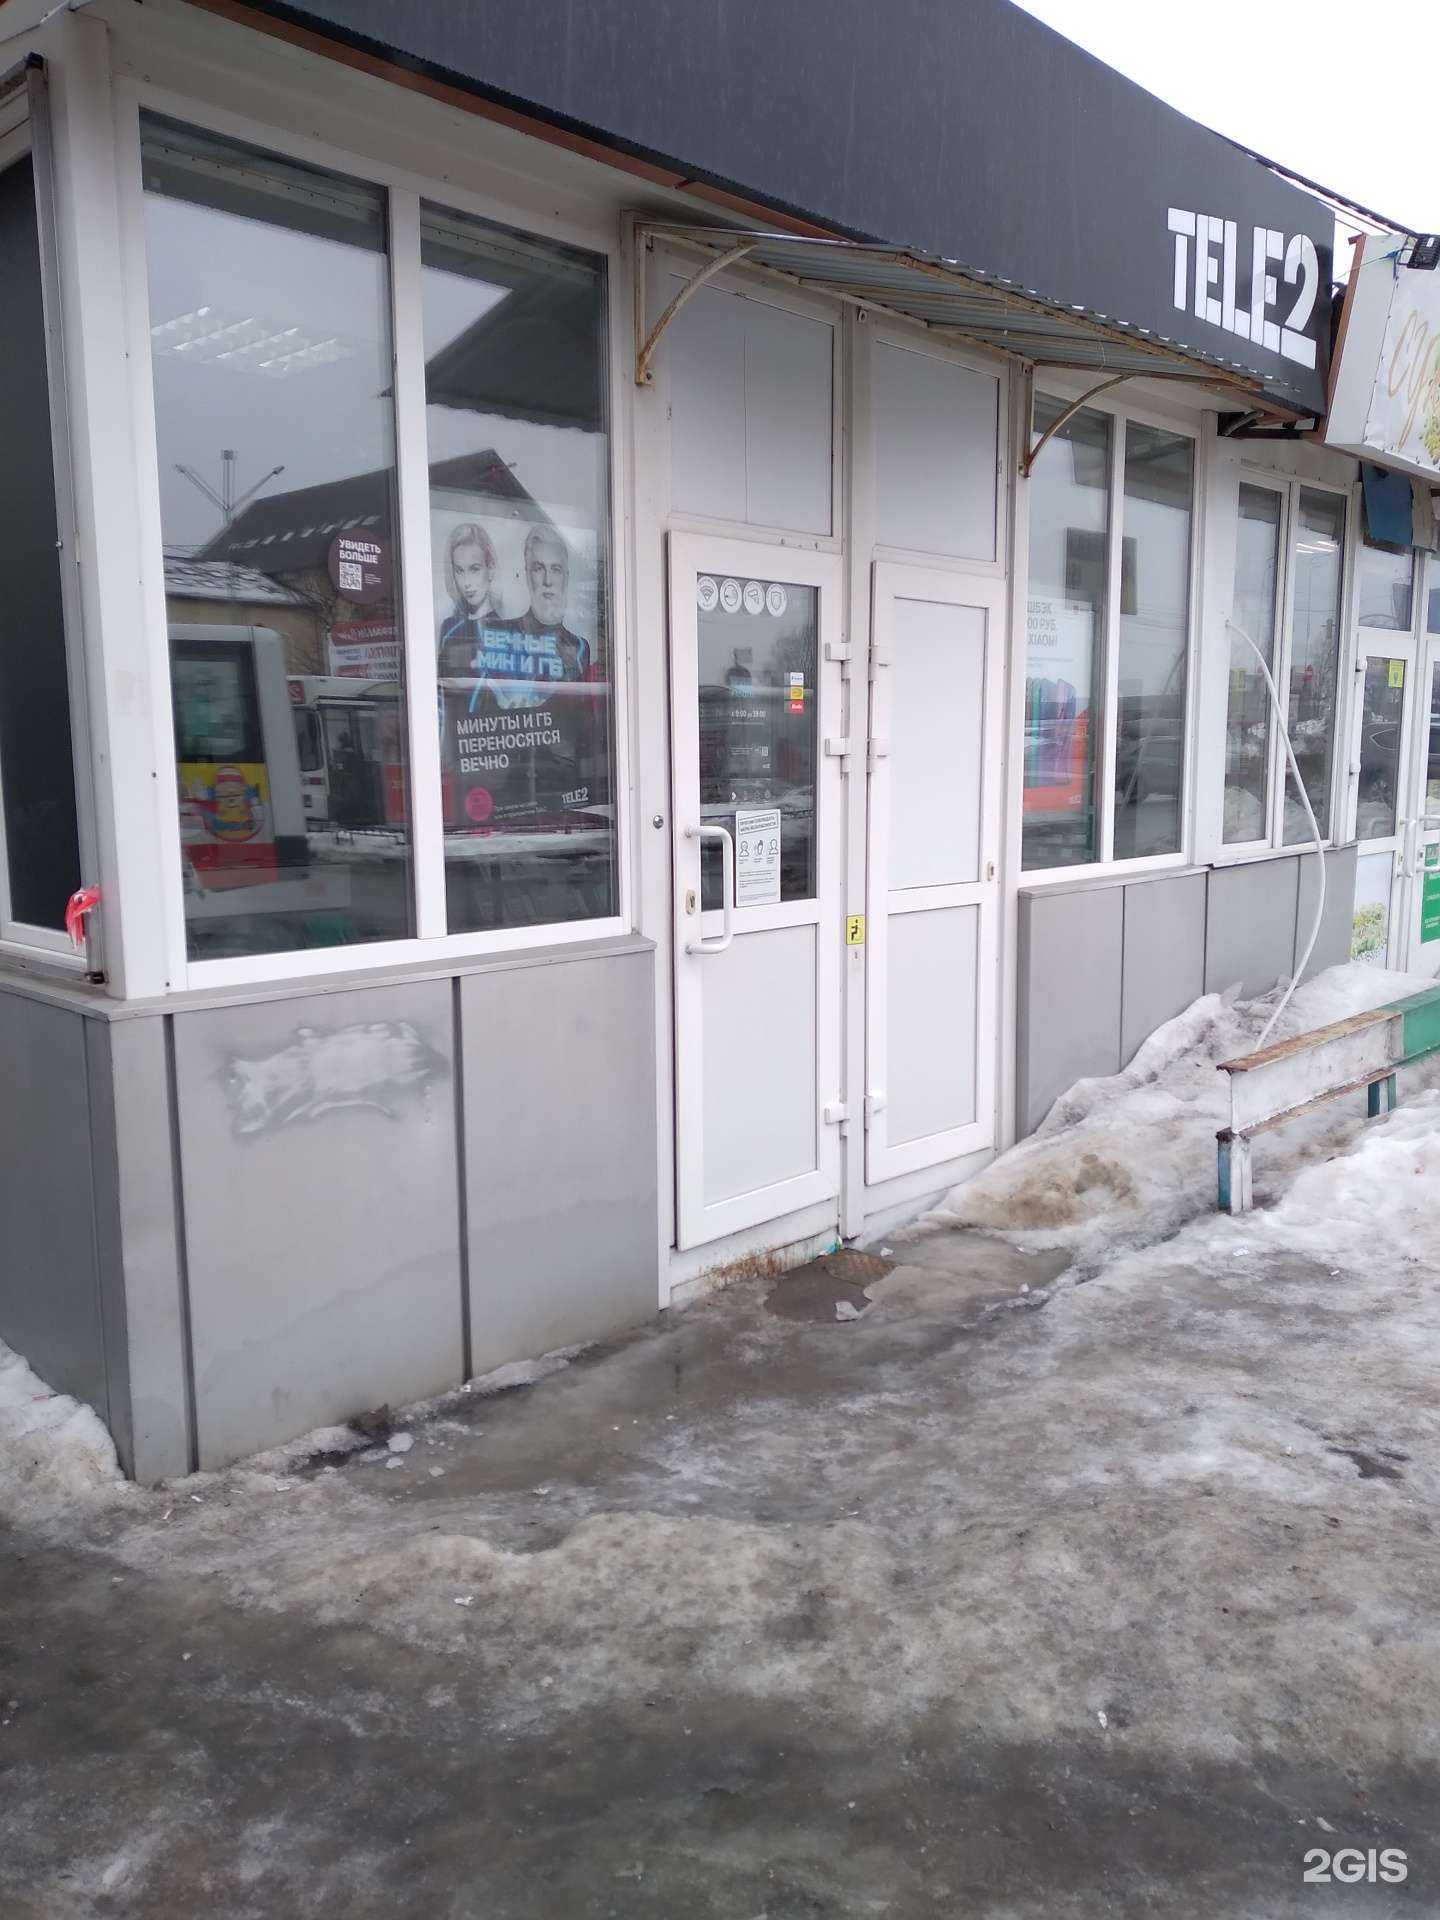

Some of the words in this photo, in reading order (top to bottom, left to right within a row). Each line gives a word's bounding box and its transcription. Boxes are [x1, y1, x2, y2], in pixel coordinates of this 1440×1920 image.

[1167, 207, 1319, 370] TELE2
[338, 538, 382, 554] УВИДЕТЬ
[339, 549, 378, 564] БОЛЬШЕ
[483, 629, 557, 655] ВЕЧНЫЕ
[475, 650, 516, 672] МИН
[520, 654, 534, 673] И
[539, 656, 563, 679] ГБ
[457, 715, 520, 735] МИНУТЫ
[523, 713, 534, 728] И
[536, 711, 552, 728] ГБ
[458, 729, 560, 754] ПЕРЕНОСЯТСЯ
[460, 754, 509, 773] ВЕЧНО
[562, 786, 589, 804] TELE2
